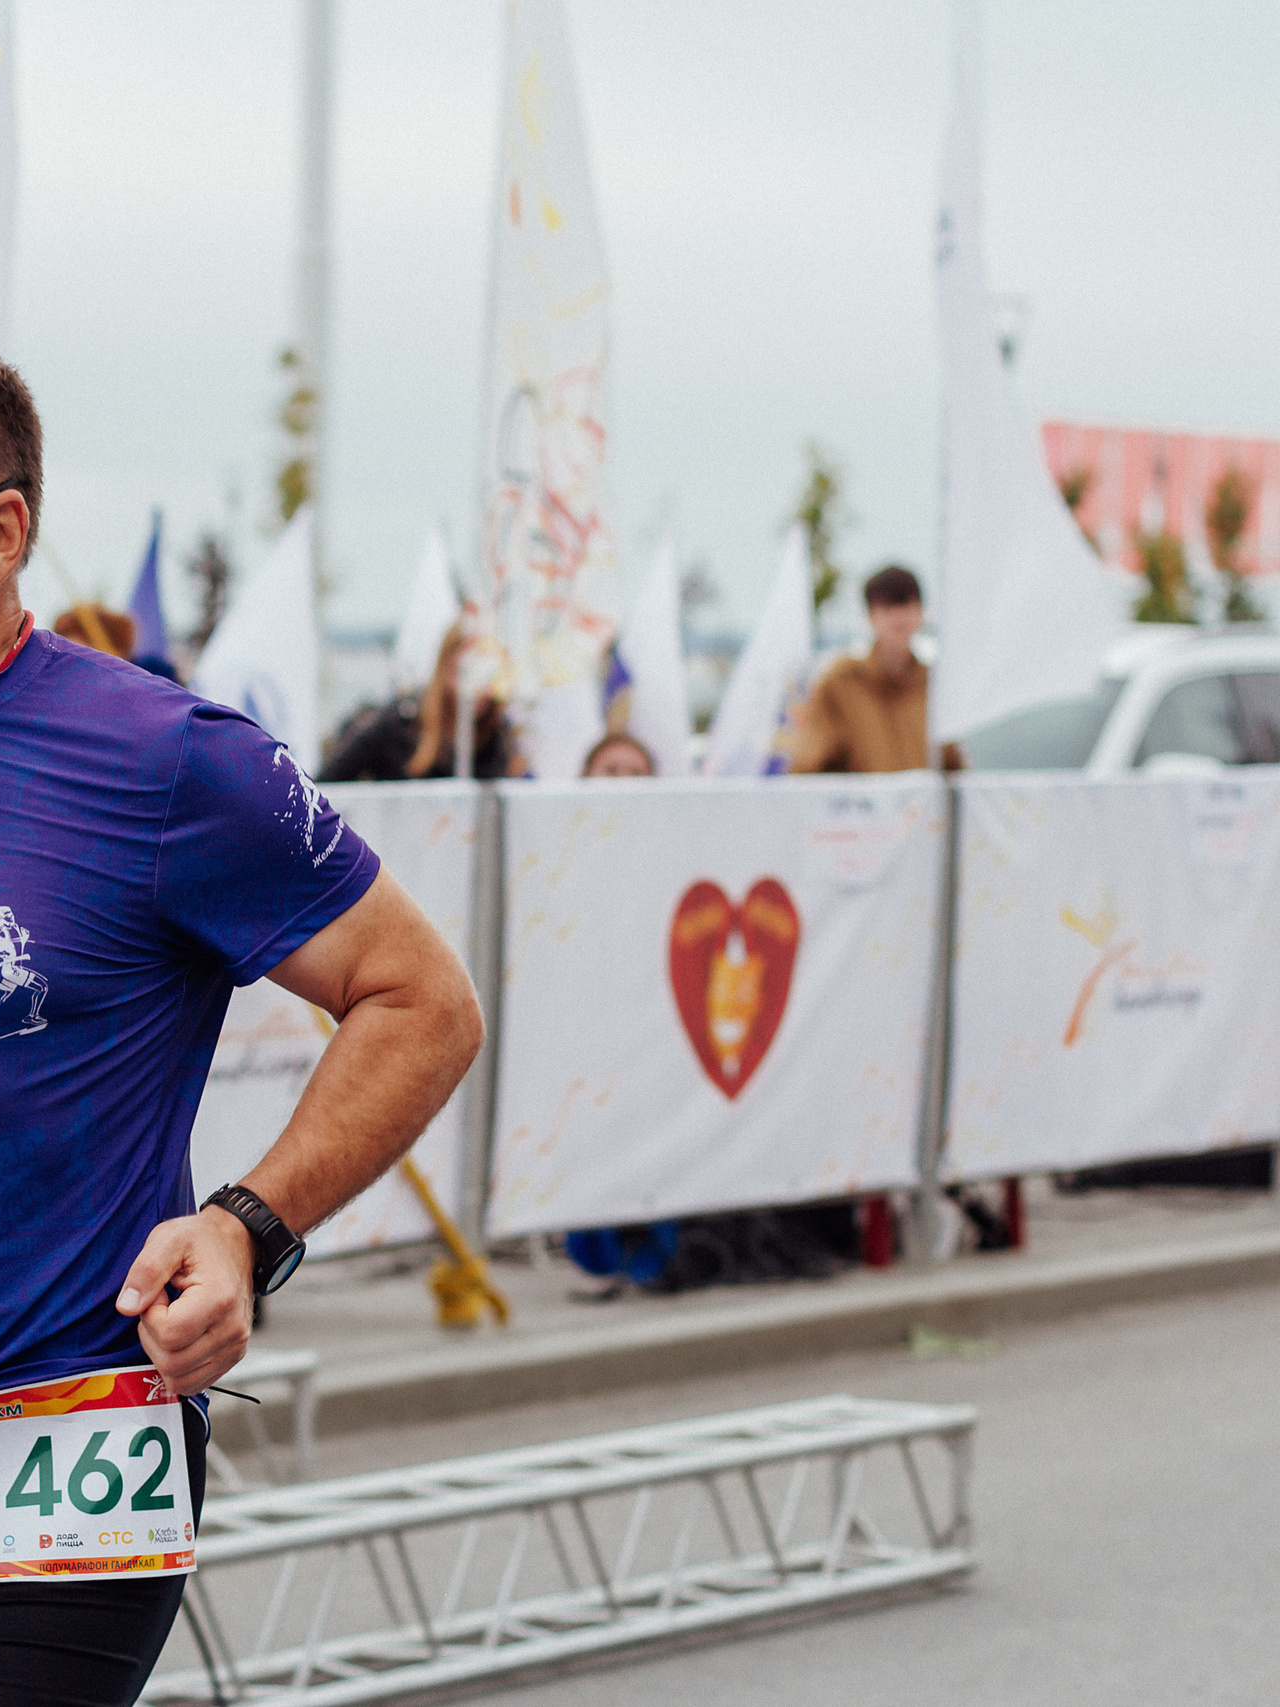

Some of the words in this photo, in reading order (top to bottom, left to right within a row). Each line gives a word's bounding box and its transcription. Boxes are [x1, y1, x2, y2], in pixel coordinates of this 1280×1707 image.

[6, 1426, 174, 1516] 462
[56, 1540, 84, 1548] ПИЦЦА
[99, 1531, 134, 1546] СТС
[40, 1560, 108, 1573] ПОЛУМАРАФОН
[111, 1558, 155, 1570] ГАНДИКАП
